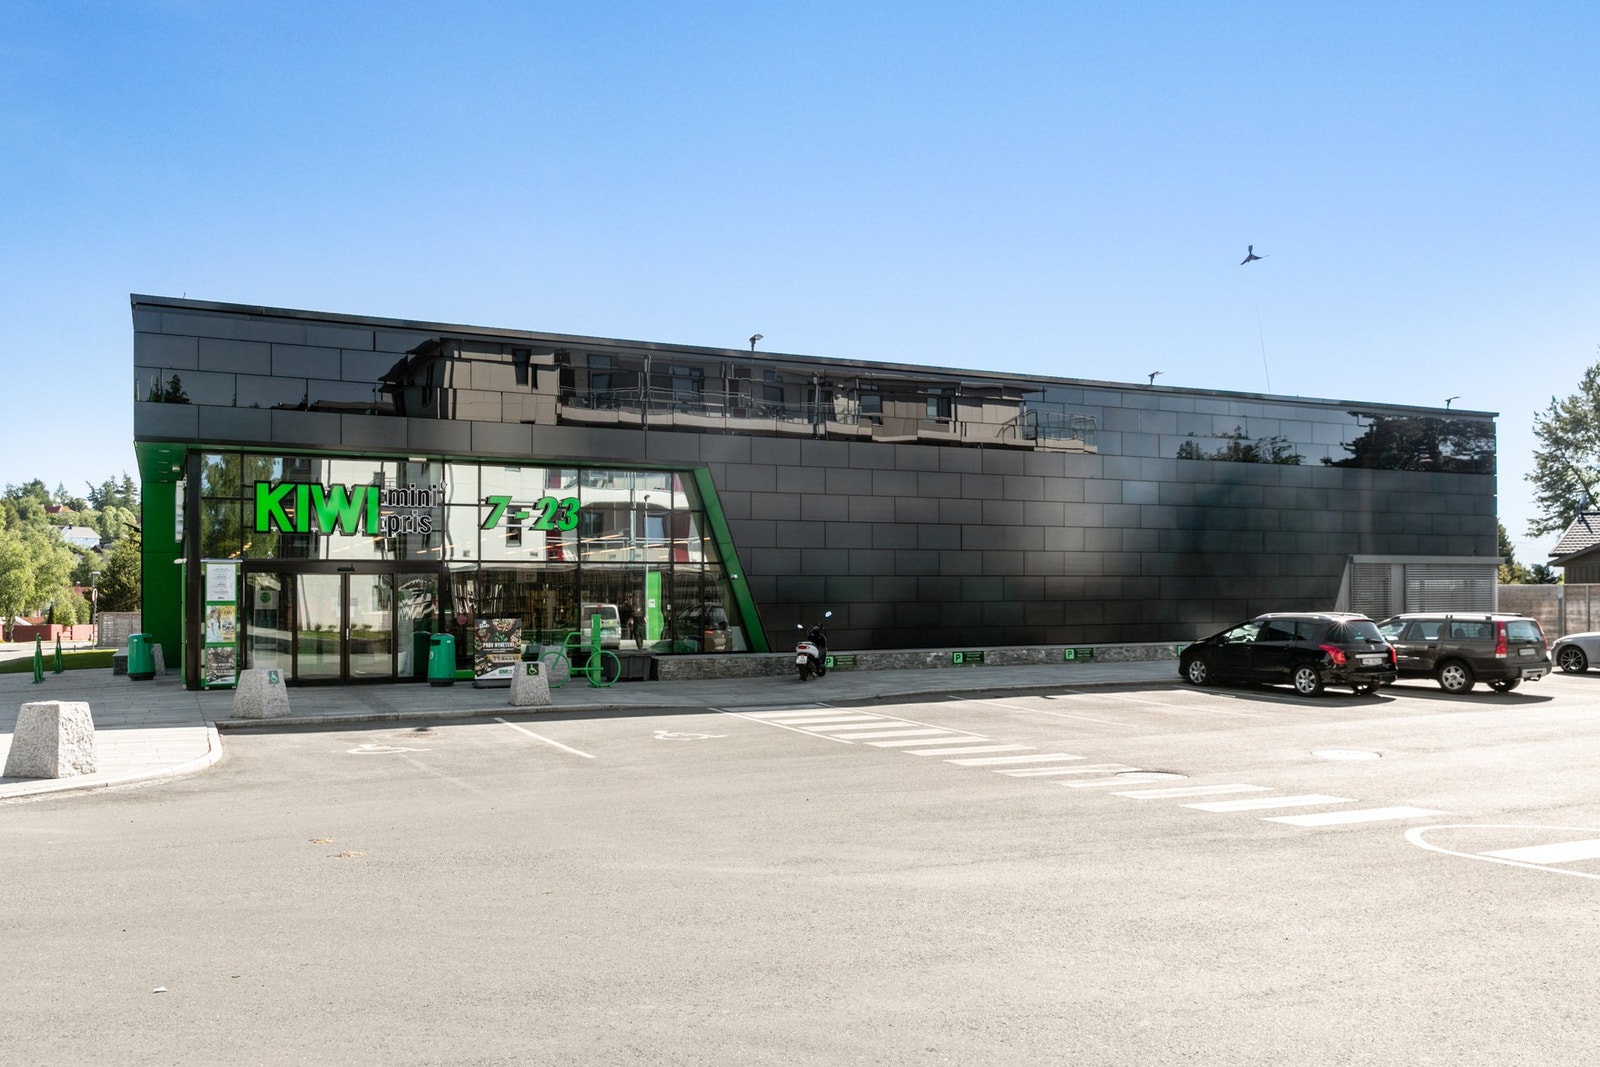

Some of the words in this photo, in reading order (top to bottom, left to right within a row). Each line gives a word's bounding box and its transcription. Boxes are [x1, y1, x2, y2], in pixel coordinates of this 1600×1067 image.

[254, 480, 381, 537] KIWI
[386, 482, 438, 508] mini
[386, 509, 433, 538] pris
